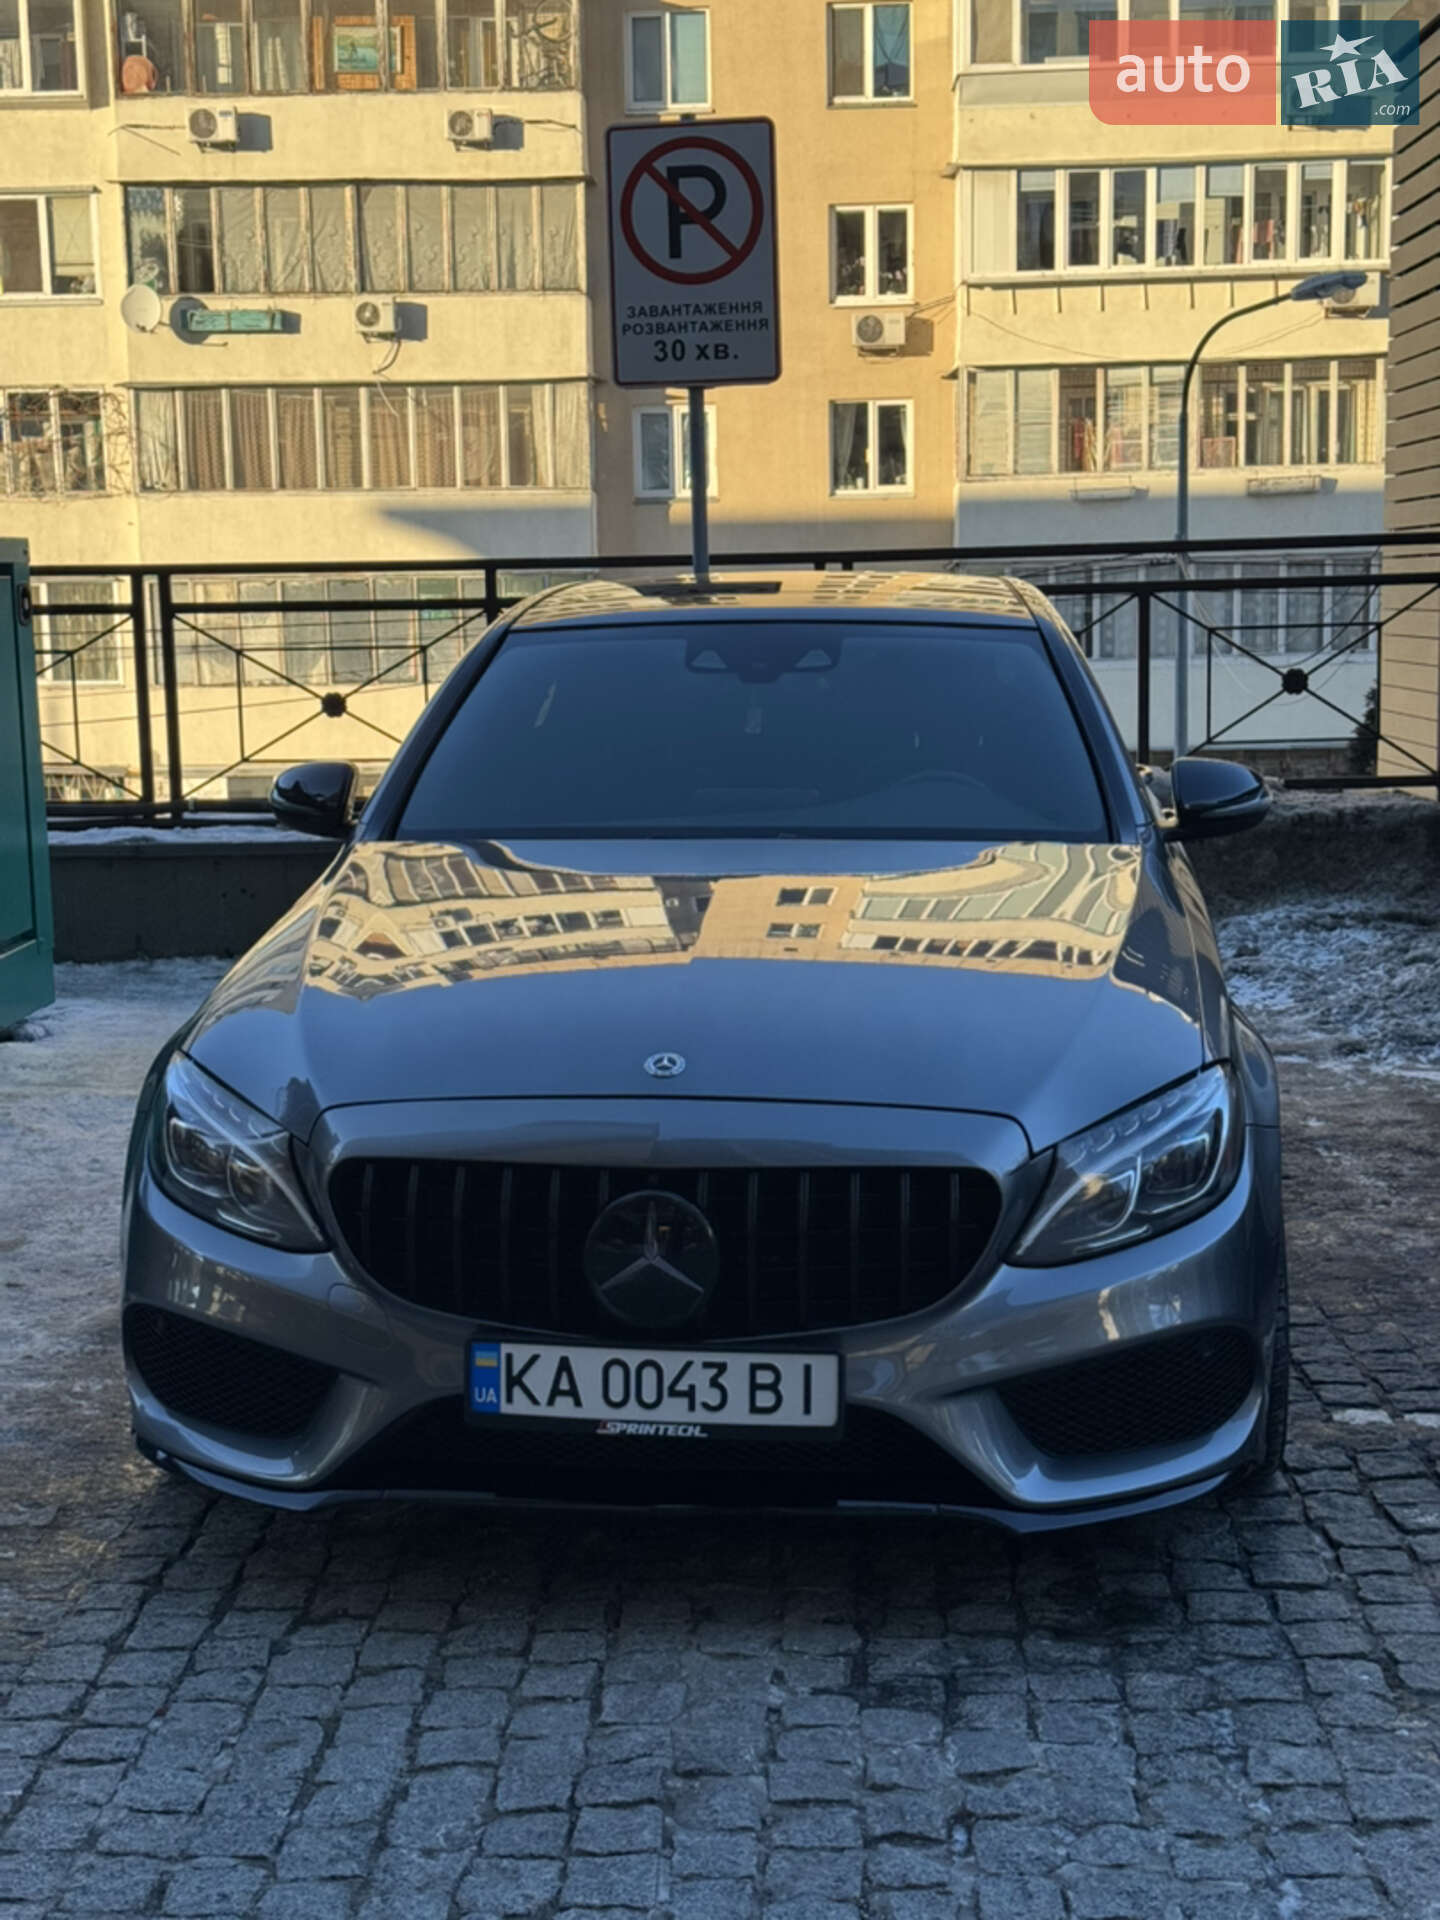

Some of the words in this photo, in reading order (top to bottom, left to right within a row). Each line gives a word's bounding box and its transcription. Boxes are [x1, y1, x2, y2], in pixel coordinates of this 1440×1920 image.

[626, 301, 763, 319] ЗАВАНТАЖЕННЯ
[621, 318, 769, 336] РОЗВАНТАЖЕННЯ
[653, 339, 686, 362] 30
[474, 1386, 498, 1404] UA
[505, 1352, 583, 1409] KA
[602, 1357, 728, 1413] 0043
